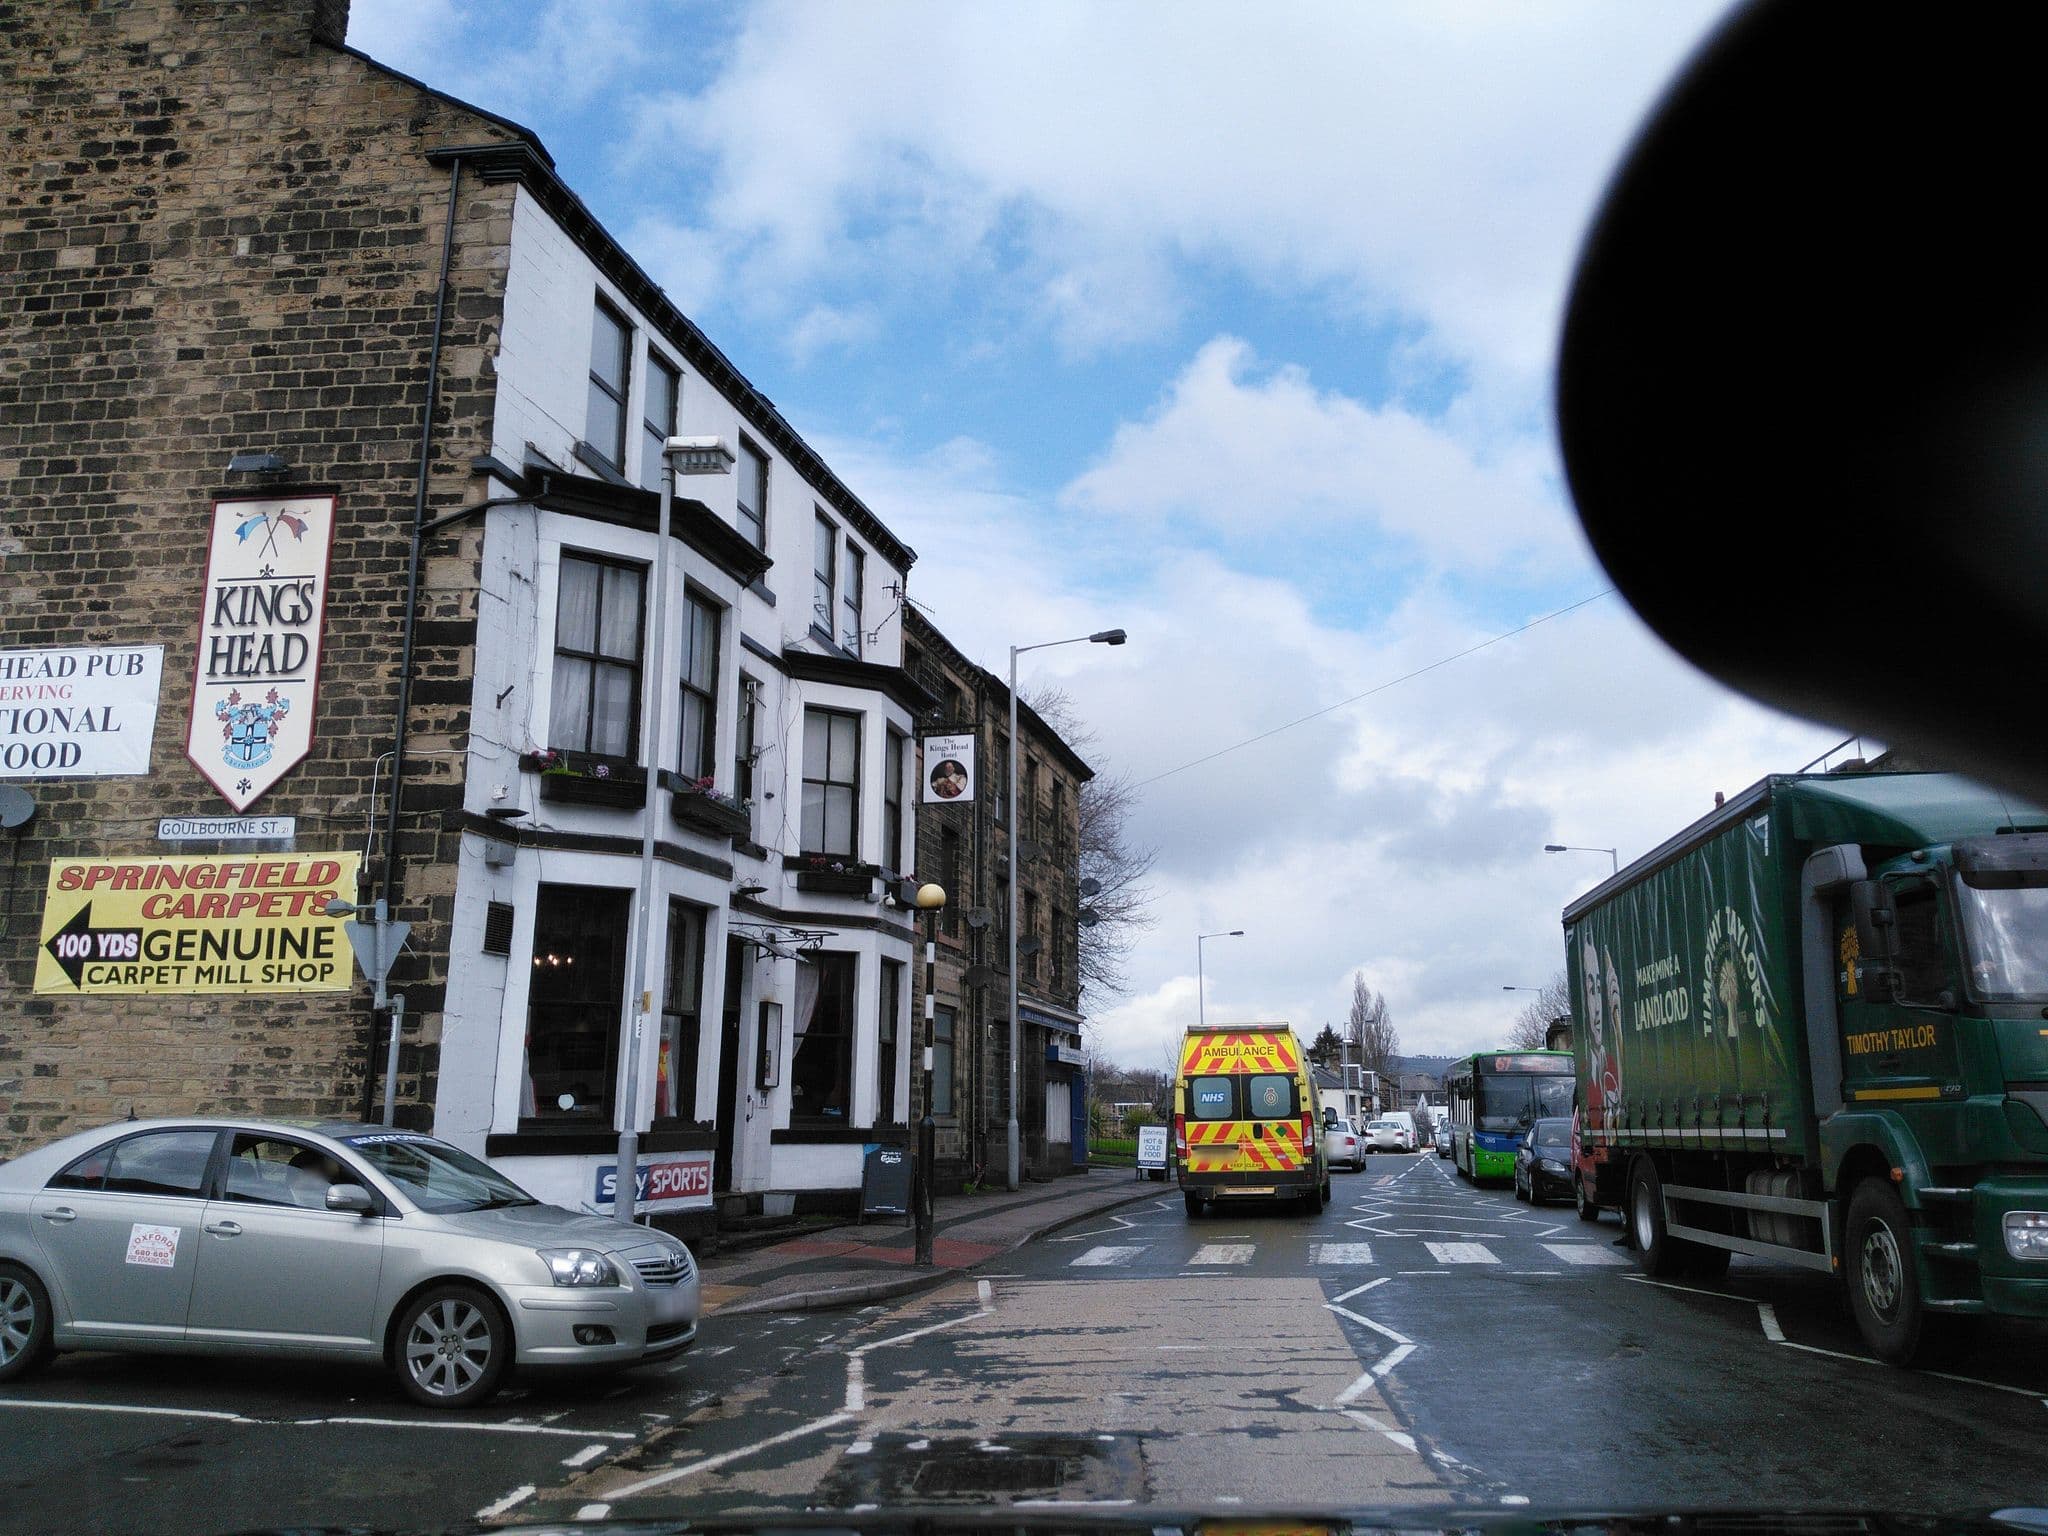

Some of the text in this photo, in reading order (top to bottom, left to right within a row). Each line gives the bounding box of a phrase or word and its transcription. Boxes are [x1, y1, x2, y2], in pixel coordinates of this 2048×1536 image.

[211, 580, 315, 627] KINGS
[85, 653, 144, 677] PUB
[206, 632, 309, 677] HEAD
[0, 742, 82, 769] OOD
[161, 821, 256, 835] GOULBOURNE
[56, 861, 341, 890] SPRINGFIELD
[141, 890, 339, 919] CARPETS
[56, 926, 336, 962] 100 YDS GENUINE
[87, 963, 335, 985] CARPET MILL SHOP
[1636, 953, 1681, 988] MAKE MINE A
[1703, 908, 1722, 1038] TIMOTHY
[1633, 986, 1689, 1032] LANDLORD
[1203, 1046, 1275, 1057] AMBULANCE
[1846, 1024, 1936, 1055] TIMOTHY TAYLOR
[1201, 1093, 1225, 1103] NHS
[651, 1166, 708, 1194] SPORTS
[135, 1234, 173, 1247] OXFORD
